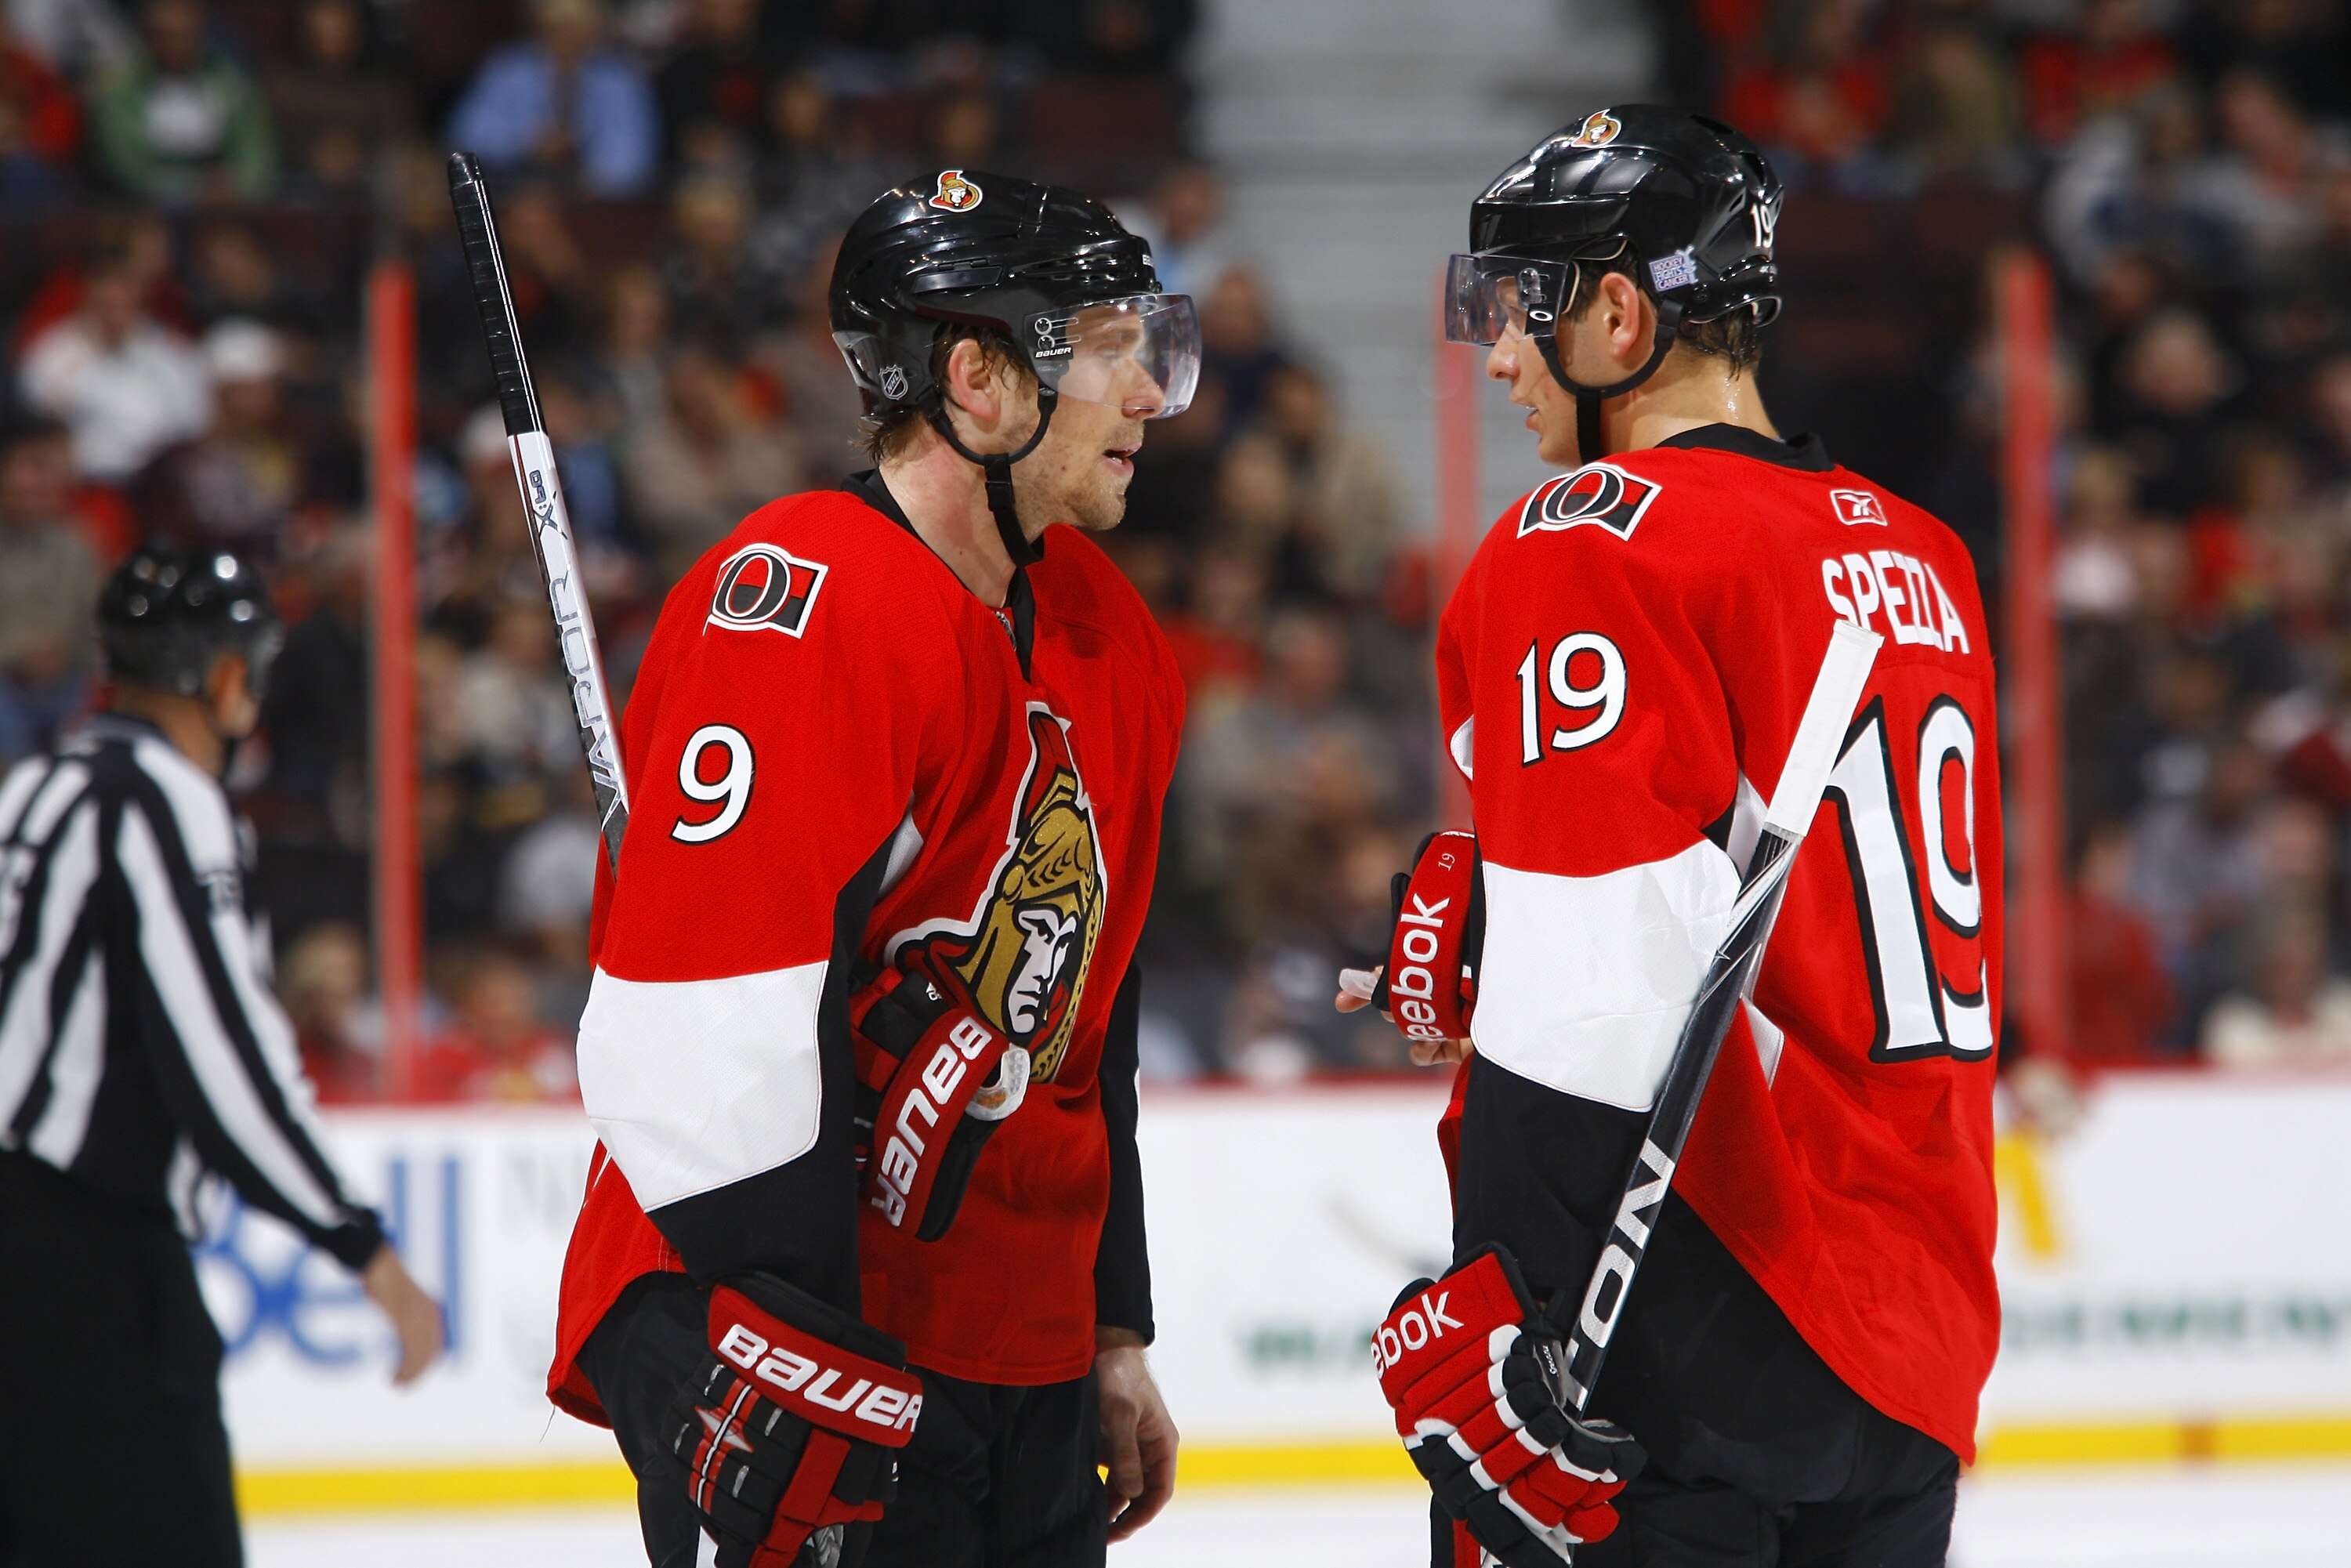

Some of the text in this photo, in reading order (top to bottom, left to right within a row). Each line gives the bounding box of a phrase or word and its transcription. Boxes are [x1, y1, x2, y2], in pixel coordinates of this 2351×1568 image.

[1654, 257, 1683, 273] HOCKEY
[1654, 267, 1682, 282] FIGHTS
[1750, 202, 1773, 248] 19
[1658, 274, 1688, 289] CANCER
[1822, 550, 1971, 655] SPEZZA
[549, 552, 625, 832] VAPOR
[1515, 630, 1628, 768] 19
[669, 722, 757, 846] 9
[1438, 853, 1455, 871] 19
[1822, 693, 1994, 1063] 19
[1391, 893, 1451, 1041] eebok
[871, 1016, 993, 1228] BAUER
[717, 1323, 923, 1433] BAUER
